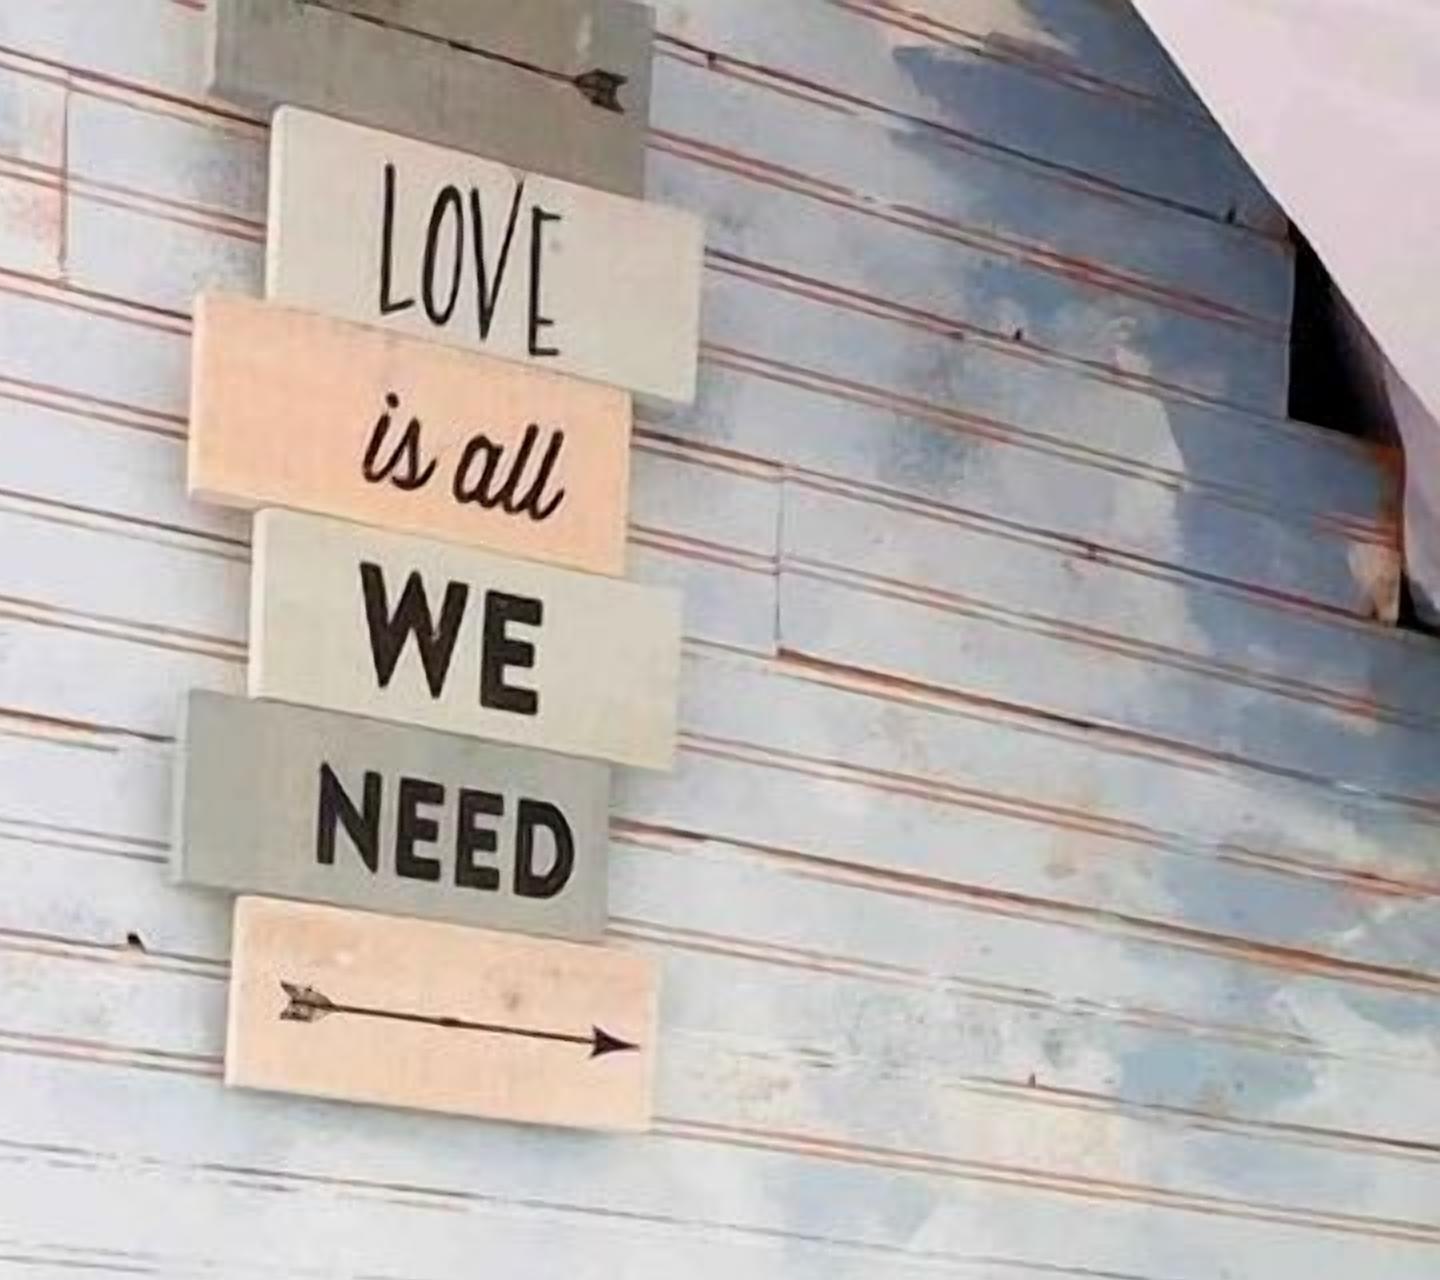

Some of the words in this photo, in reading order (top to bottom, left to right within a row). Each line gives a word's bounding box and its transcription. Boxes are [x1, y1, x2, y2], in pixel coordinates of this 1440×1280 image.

[379, 162, 563, 357] LOVE
[361, 392, 438, 491] is
[452, 423, 566, 521] all
[359, 561, 544, 716] WE
[316, 760, 576, 901] NEED
